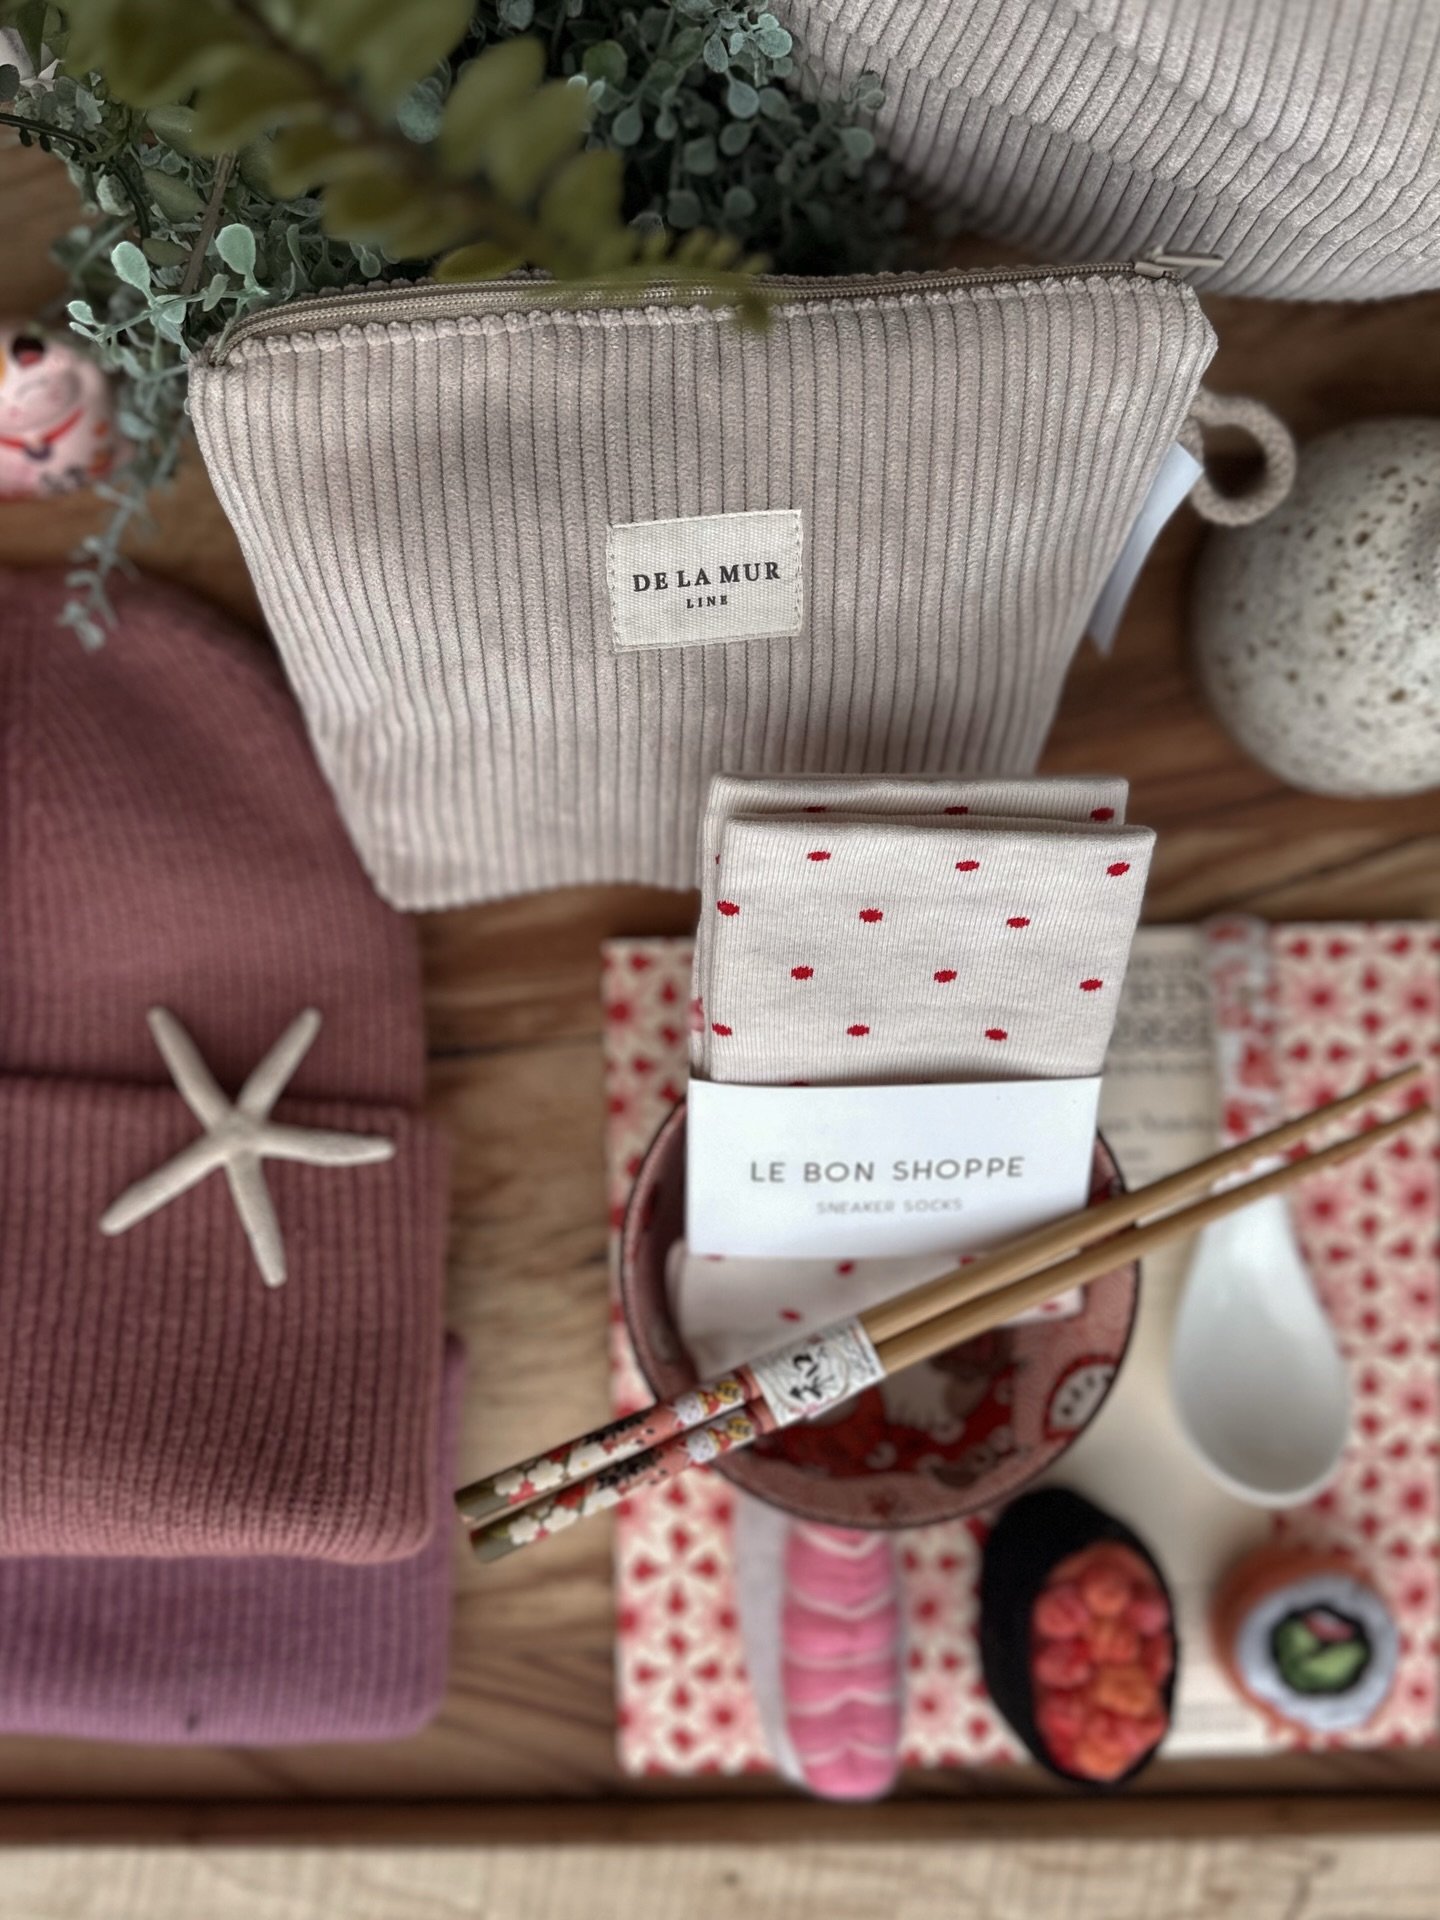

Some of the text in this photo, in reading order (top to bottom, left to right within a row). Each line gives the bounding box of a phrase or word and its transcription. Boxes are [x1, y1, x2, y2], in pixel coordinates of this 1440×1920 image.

[633, 561, 780, 592] DE LA MUR
[686, 595, 728, 609] LINE
[750, 1156, 1025, 1183] LE BON SHOPPE
[816, 1198, 963, 1215] SNEAKER SOCKS
